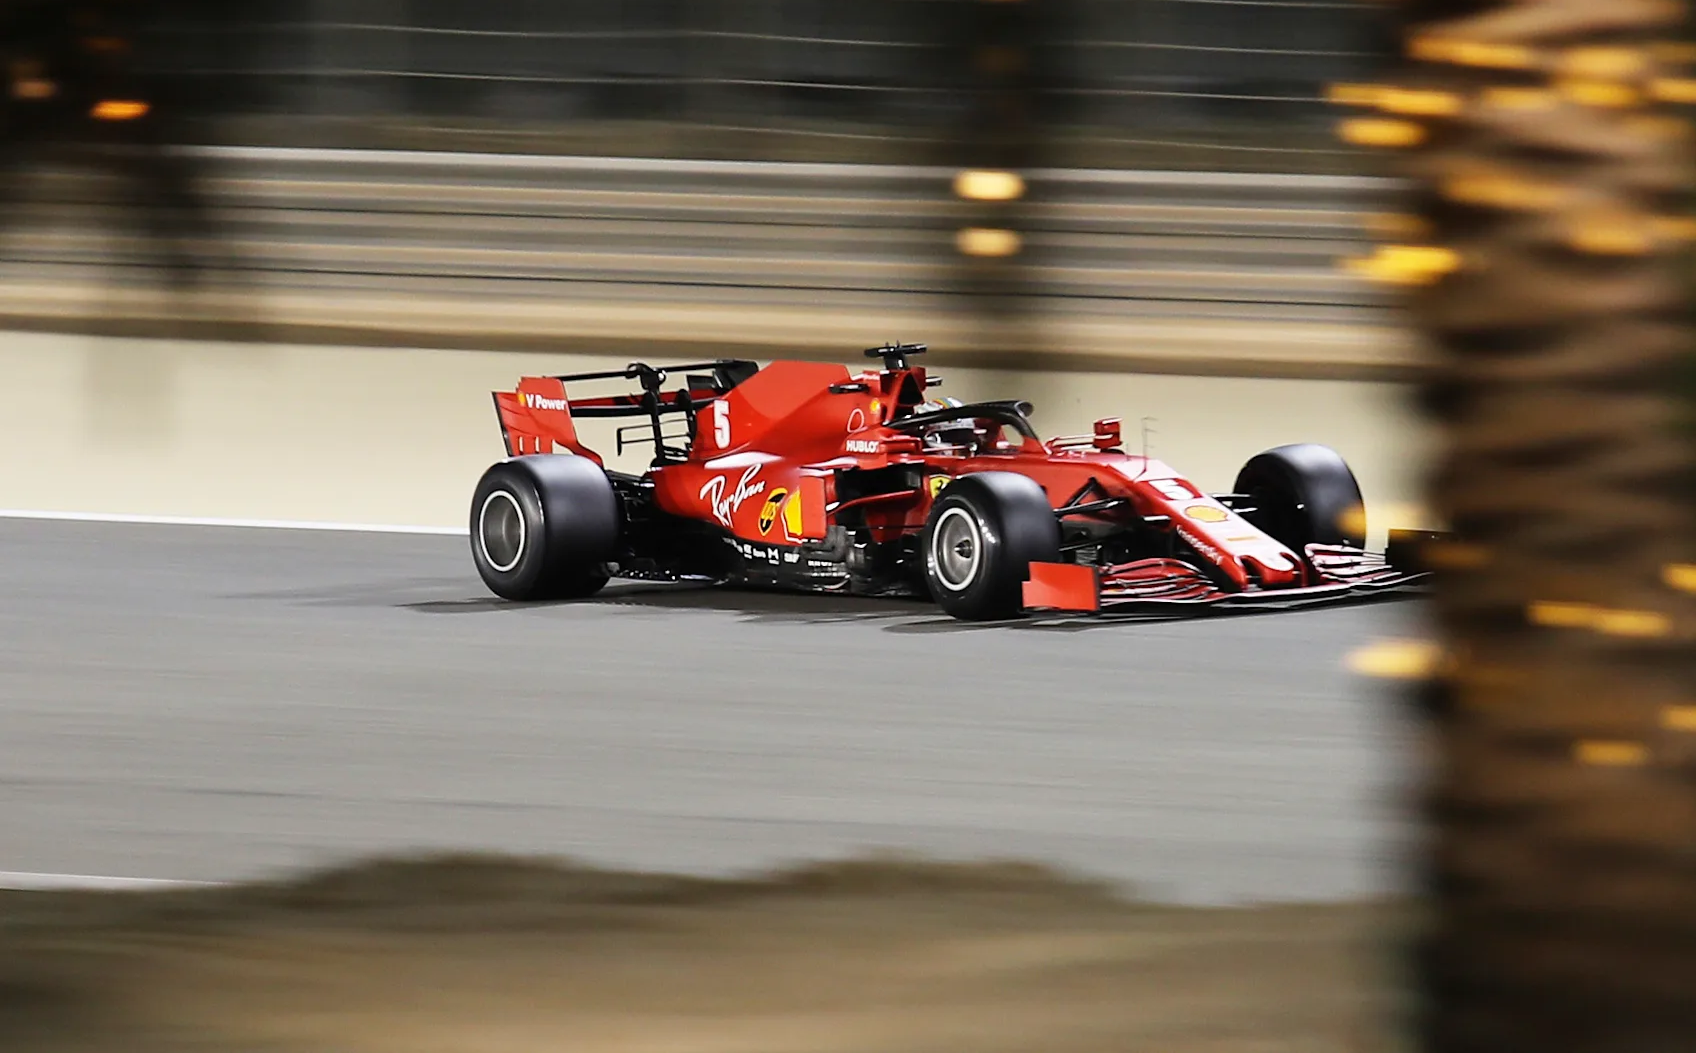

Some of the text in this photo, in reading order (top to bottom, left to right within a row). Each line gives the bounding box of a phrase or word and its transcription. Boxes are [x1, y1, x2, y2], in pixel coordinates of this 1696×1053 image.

[525, 393, 567, 410] V Power
[713, 399, 731, 449] 5
